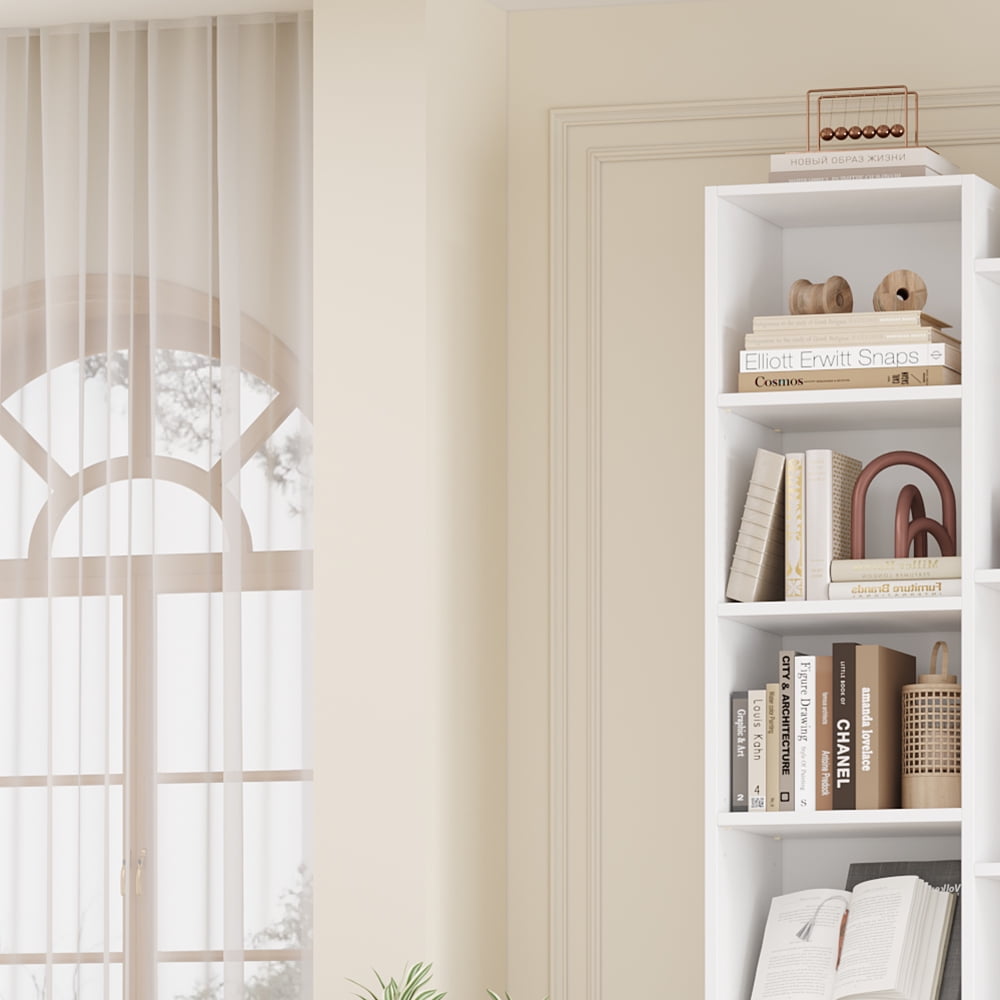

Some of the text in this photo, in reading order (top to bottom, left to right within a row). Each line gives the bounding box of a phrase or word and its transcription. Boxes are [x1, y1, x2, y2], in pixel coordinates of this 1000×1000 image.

[790, 152, 907, 167] НОВЫЙ ОБРАЗ ЖИЗНИ
[744, 347, 920, 372] Elliott Erwitt Snaps
[754, 374, 804, 388] Cosmos
[797, 662, 812, 742] Figure Drawing
[735, 709, 747, 737] Graphic
[781, 655, 791, 776] CITY & ARCHITECTURE
[753, 699, 763, 761] Louis Kahn
[861, 687, 871, 771] amanda lovelace
[737, 745, 746, 758] Art
[836, 719, 851, 789] CHANEL
[737, 794, 744, 802] 2
[754, 785, 761, 795] 4
